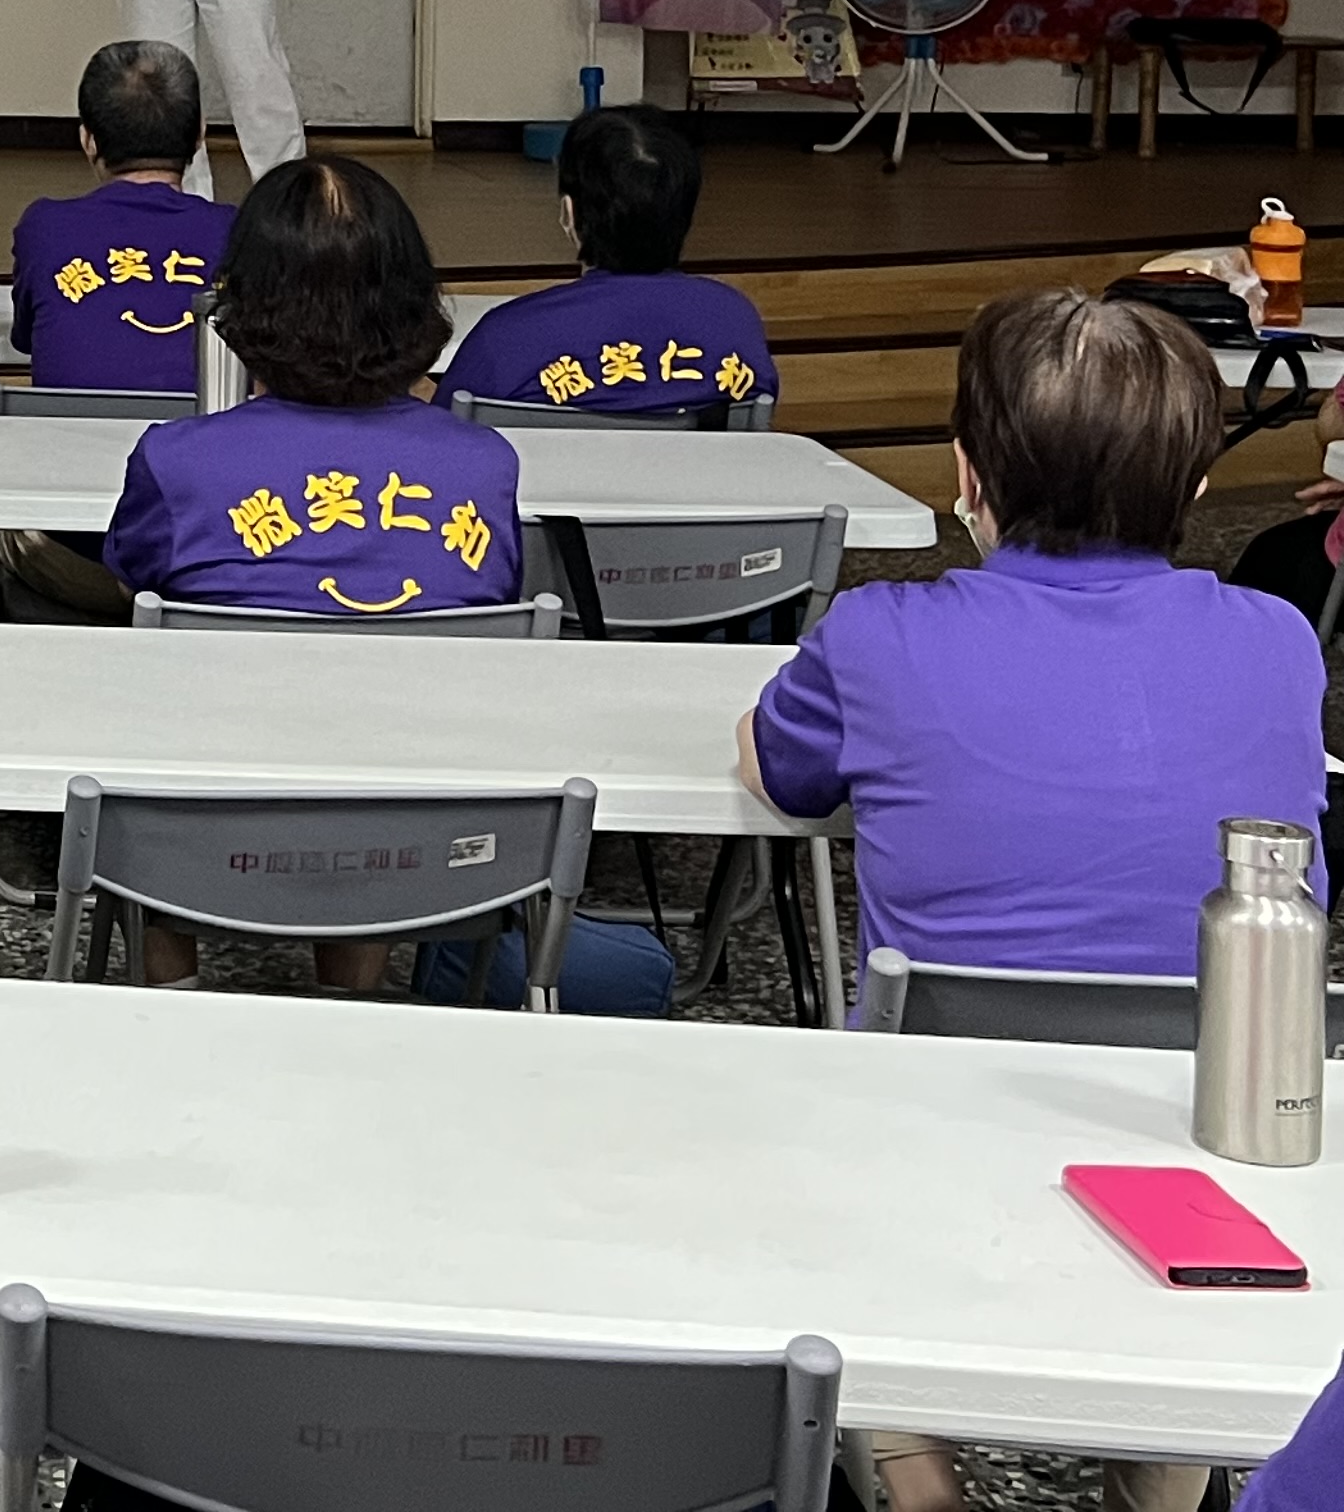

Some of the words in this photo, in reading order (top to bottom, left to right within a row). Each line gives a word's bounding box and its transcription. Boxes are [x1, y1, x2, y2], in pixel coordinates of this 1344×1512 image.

[54, 247, 224, 303] 微笑仁
[540, 340, 755, 405] 微笑仁和
[228, 471, 492, 572] 微笑仁和
